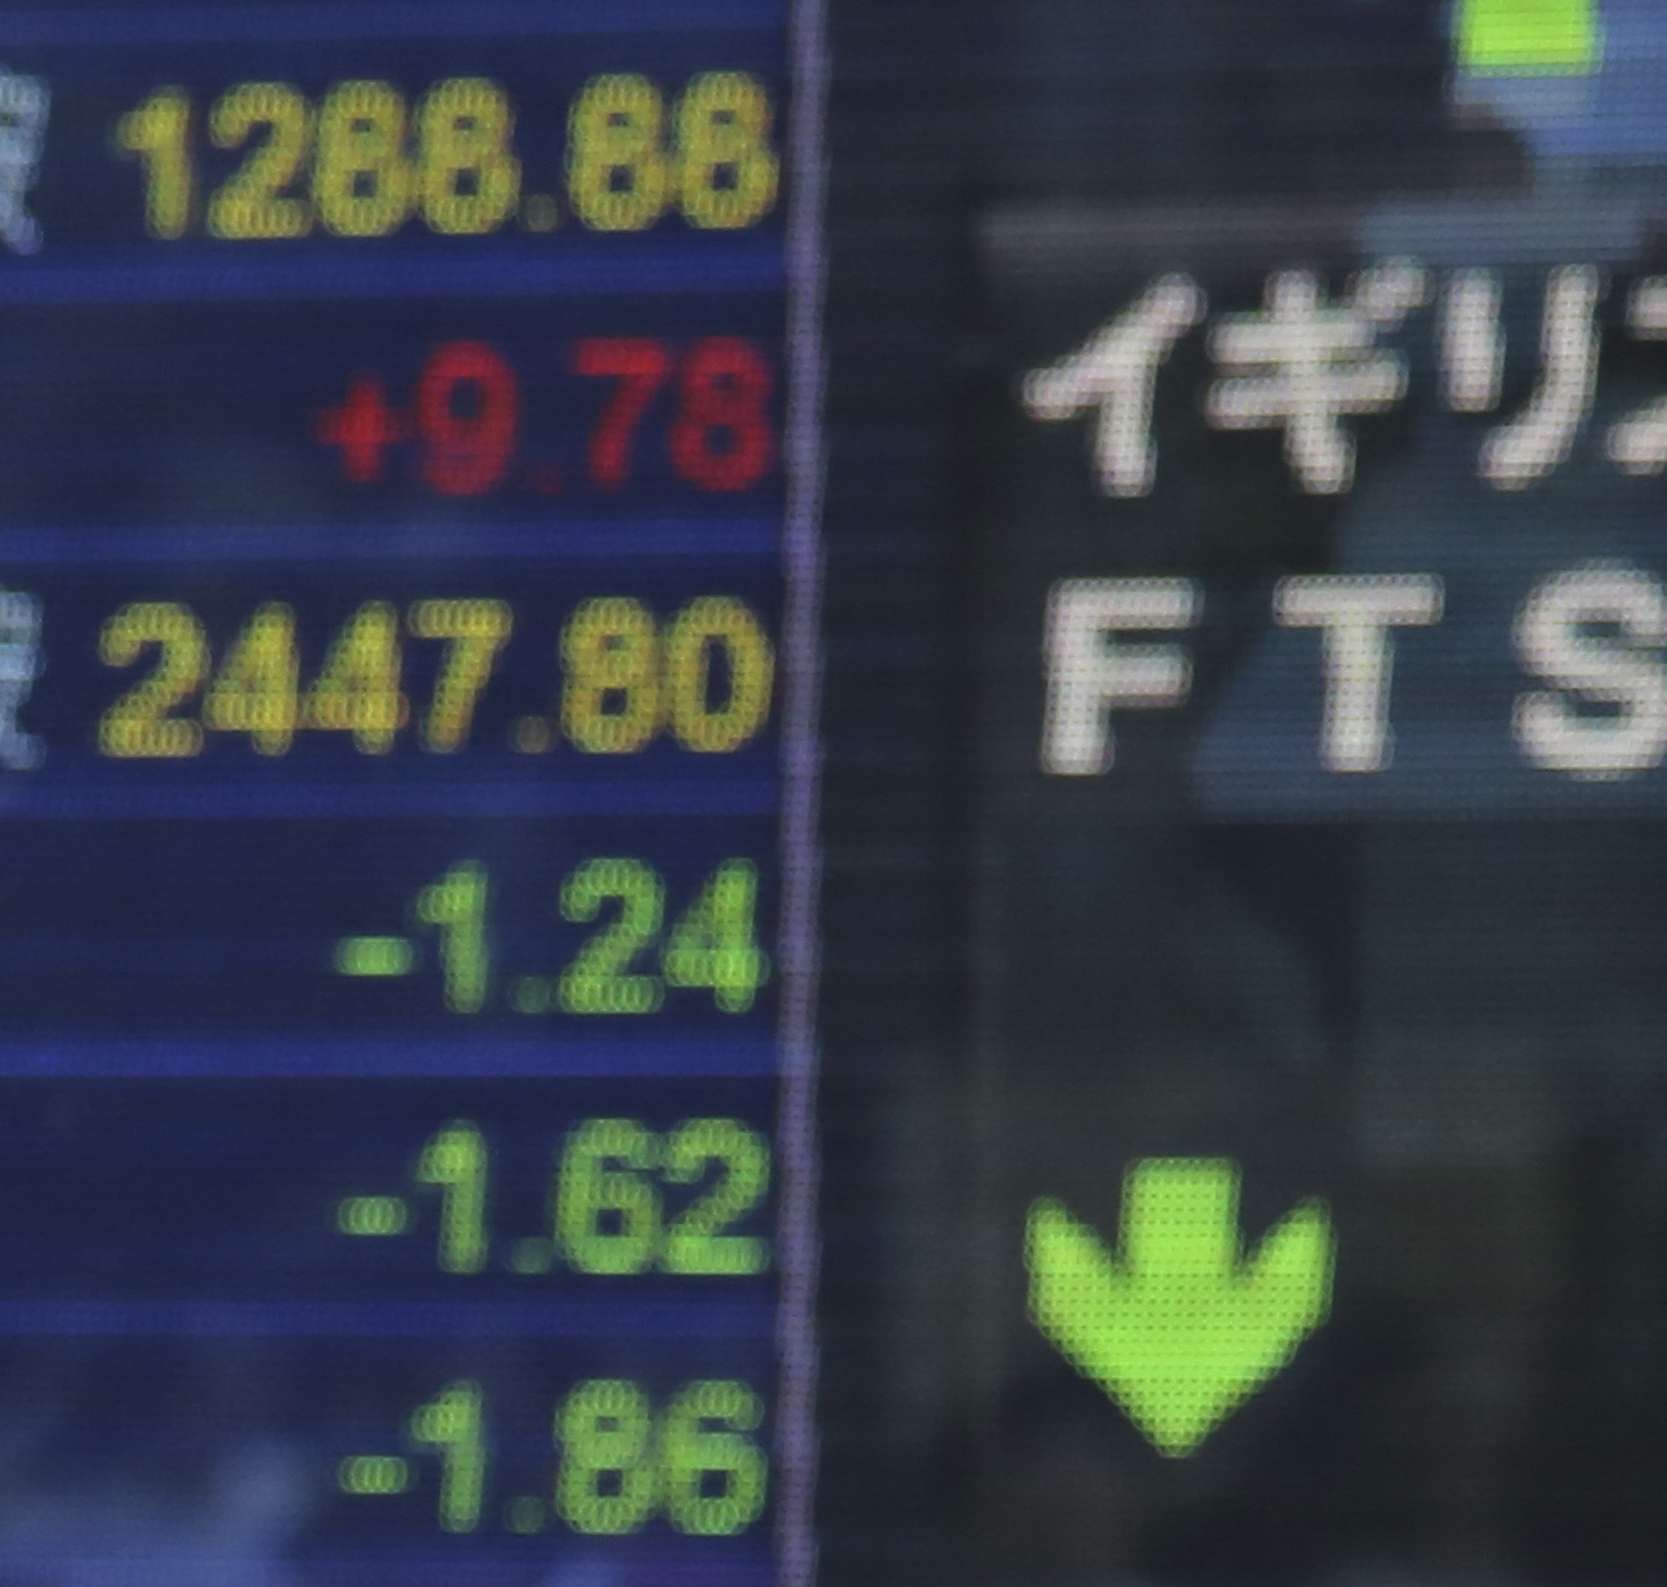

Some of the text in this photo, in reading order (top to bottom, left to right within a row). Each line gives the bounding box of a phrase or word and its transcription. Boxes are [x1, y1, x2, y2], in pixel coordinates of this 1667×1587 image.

[317, 336, 773, 496] +9.78
[1020, 255, 1667, 498] イギリ
[99, 598, 774, 758] 2447.80
[333, 857, 770, 1014] -1.24
[336, 1117, 770, 1275] -1.62
[336, 1378, 767, 1536] -1.86
